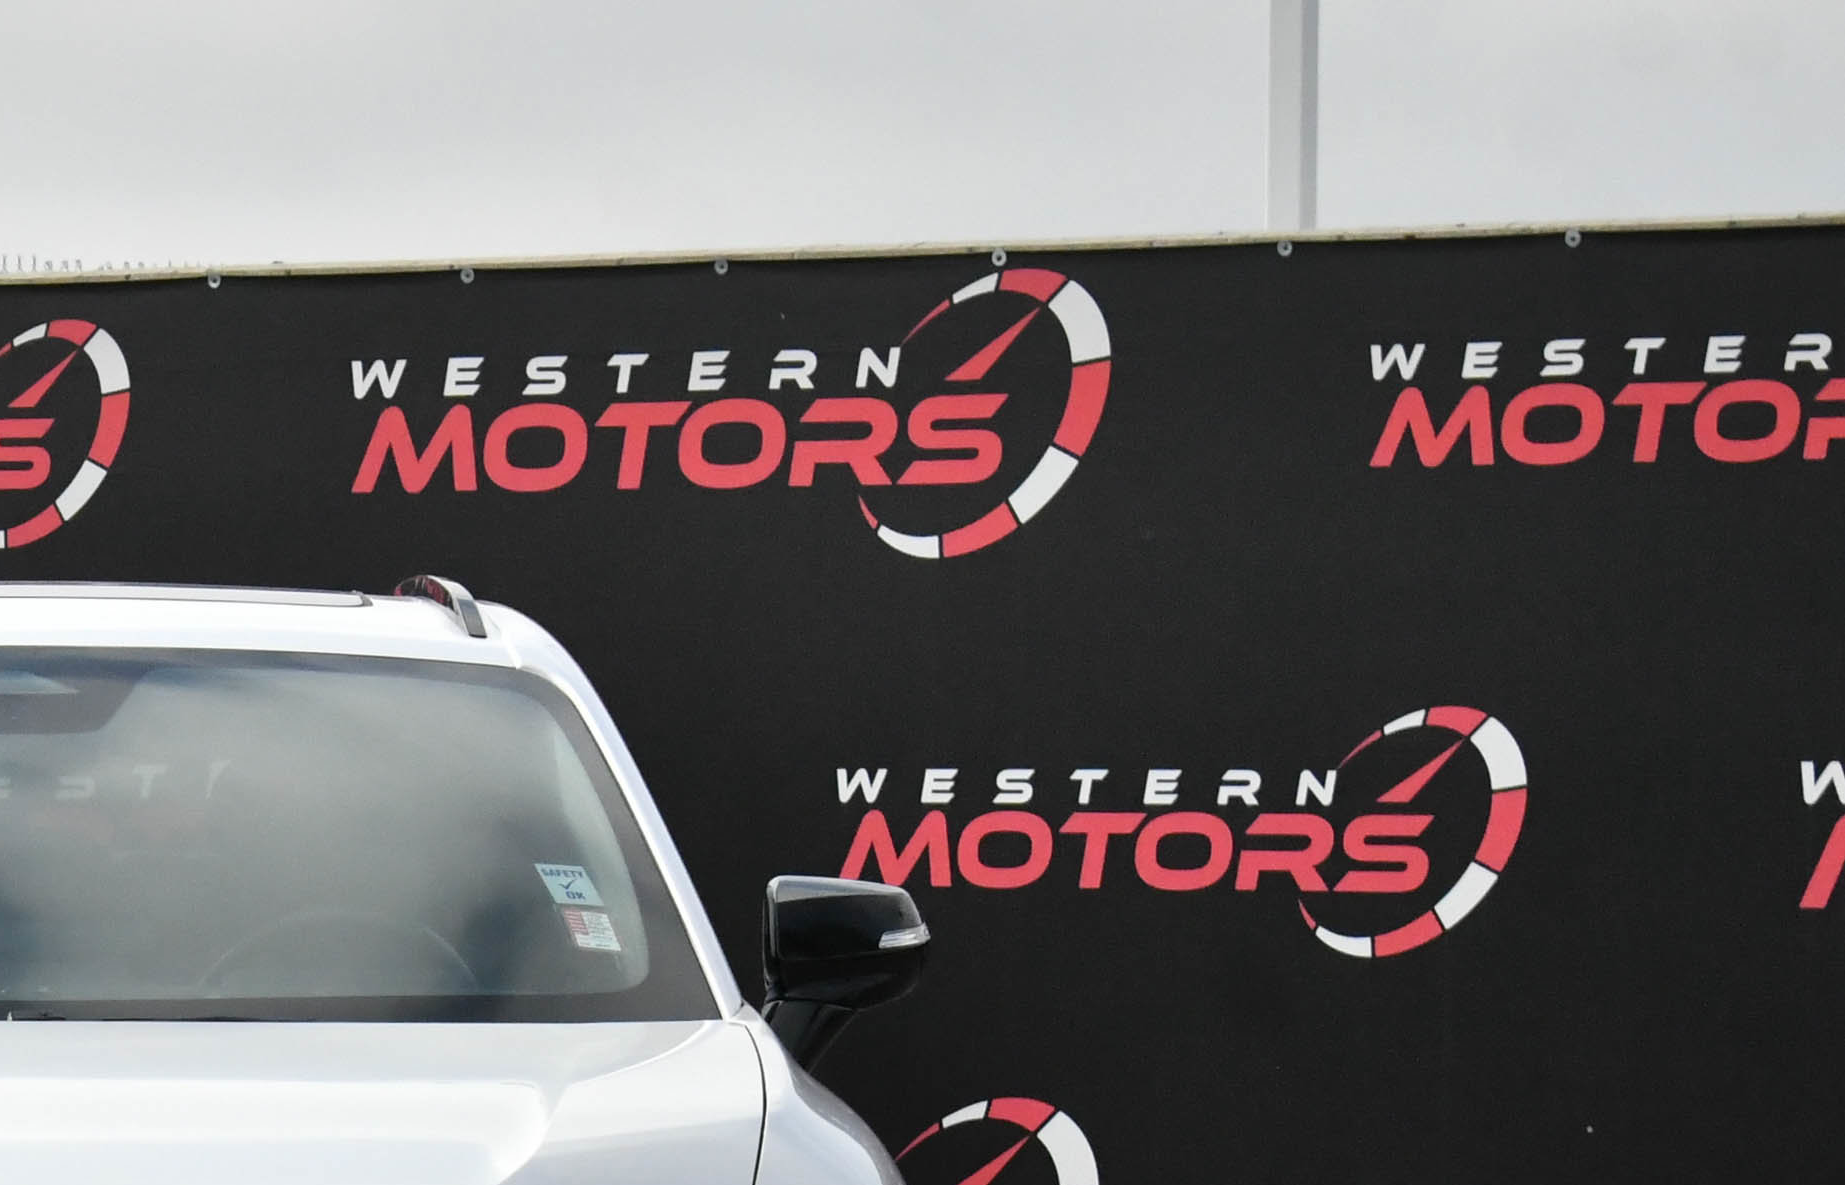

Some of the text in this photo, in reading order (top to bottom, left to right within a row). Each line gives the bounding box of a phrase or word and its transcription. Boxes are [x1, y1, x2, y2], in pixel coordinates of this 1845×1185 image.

[351, 347, 900, 399] WESTERN
[1370, 333, 1833, 380] WESTER
[352, 393, 1009, 494] MOTORS
[836, 767, 1338, 807] WESTERN
[839, 810, 1435, 893] MOTORS
